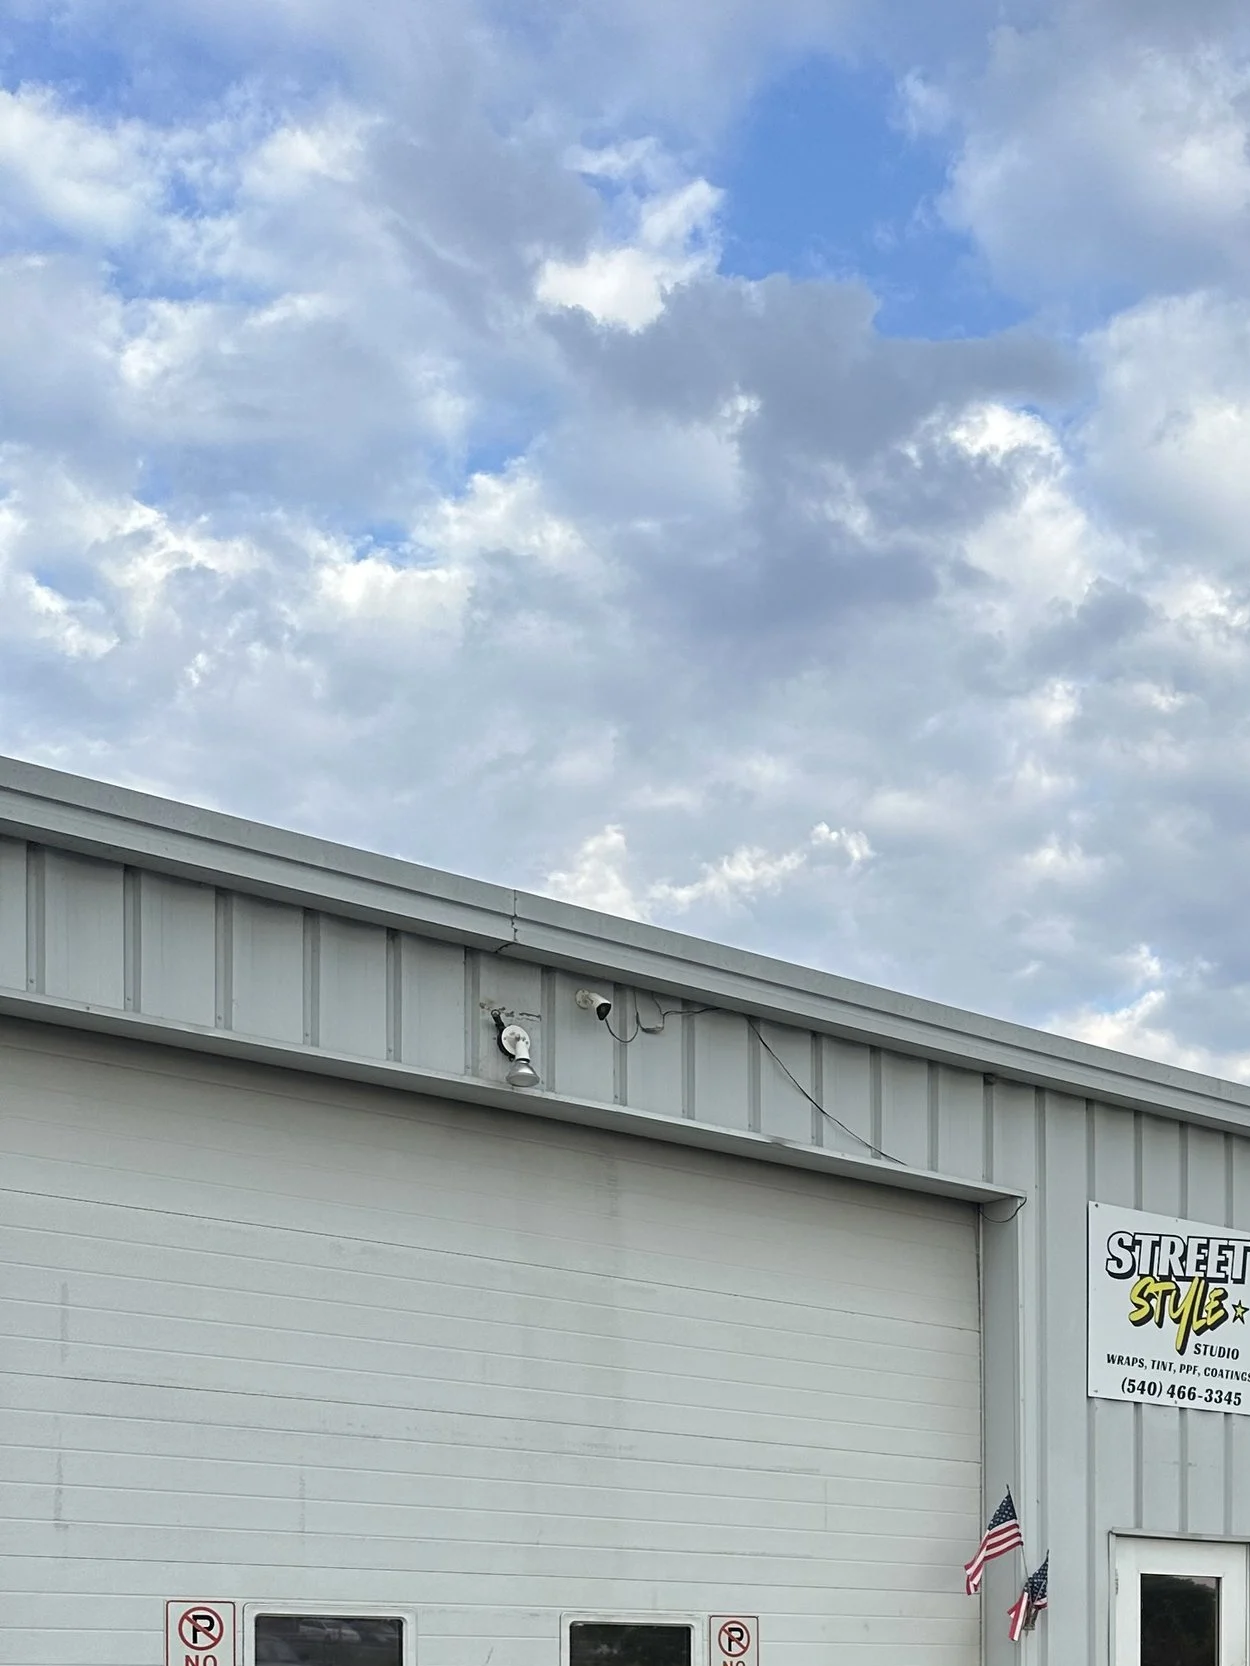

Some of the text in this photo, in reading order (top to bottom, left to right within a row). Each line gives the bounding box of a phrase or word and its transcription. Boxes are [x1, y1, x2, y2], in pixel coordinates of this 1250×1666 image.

[1194, 1343, 1240, 1360] STUDIO
[1106, 1354, 1148, 1370] WRAPS,
[1151, 1360, 1177, 1374] TINT,
[1180, 1364, 1201, 1377] PPF,
[1122, 1377, 1242, 1406] (540) 466-3345
